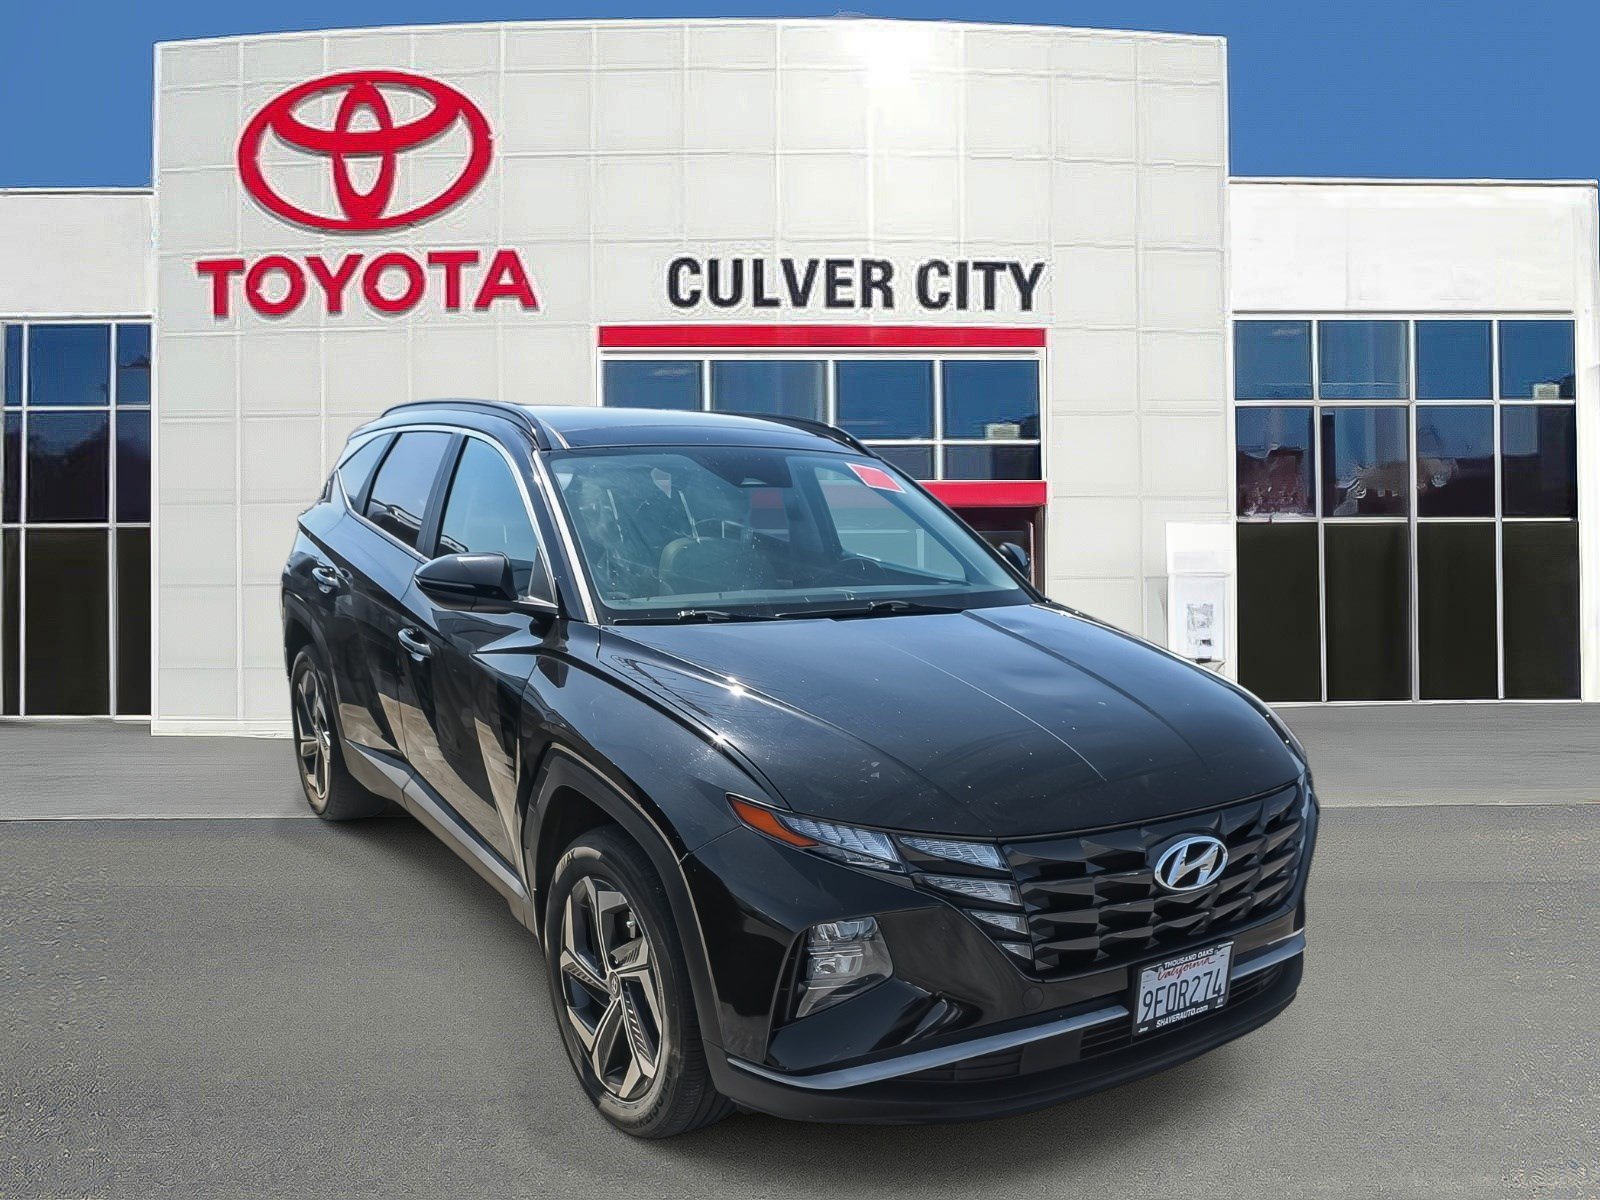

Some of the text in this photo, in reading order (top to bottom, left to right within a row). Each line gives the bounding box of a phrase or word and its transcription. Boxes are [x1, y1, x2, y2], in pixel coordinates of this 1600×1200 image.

[197, 250, 538, 319] TOYOTA
[668, 257, 1045, 311] CULVER CITY
[1157, 957, 1216, 981] California
[1164, 953, 1197, 970] THOUSAND
[1197, 948, 1214, 959] OAKS
[1156, 1004, 1209, 1028] SHAVERAUTO.com
